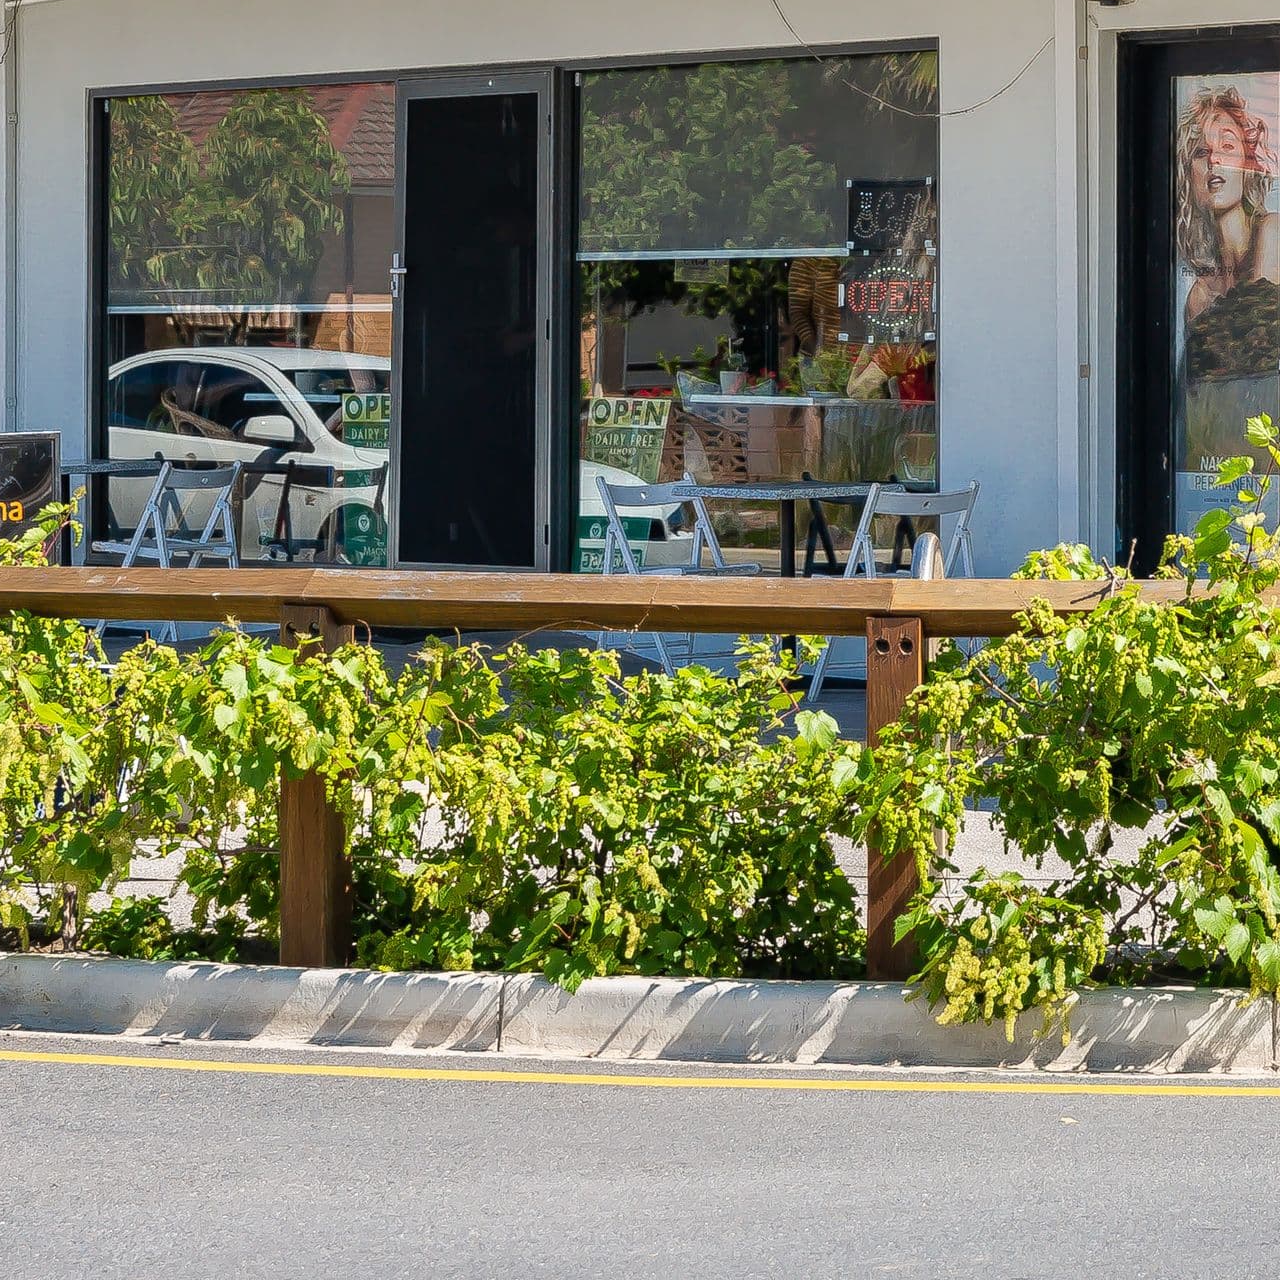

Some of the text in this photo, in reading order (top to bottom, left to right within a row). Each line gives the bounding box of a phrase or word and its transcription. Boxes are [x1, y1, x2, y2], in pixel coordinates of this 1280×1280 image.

[847, 280, 932, 313] OPEN
[345, 395, 390, 420] OPE
[591, 399, 665, 425] OPEN
[351, 428, 380, 440] DAIRY
[595, 434, 654, 447] DAIRY FREE
